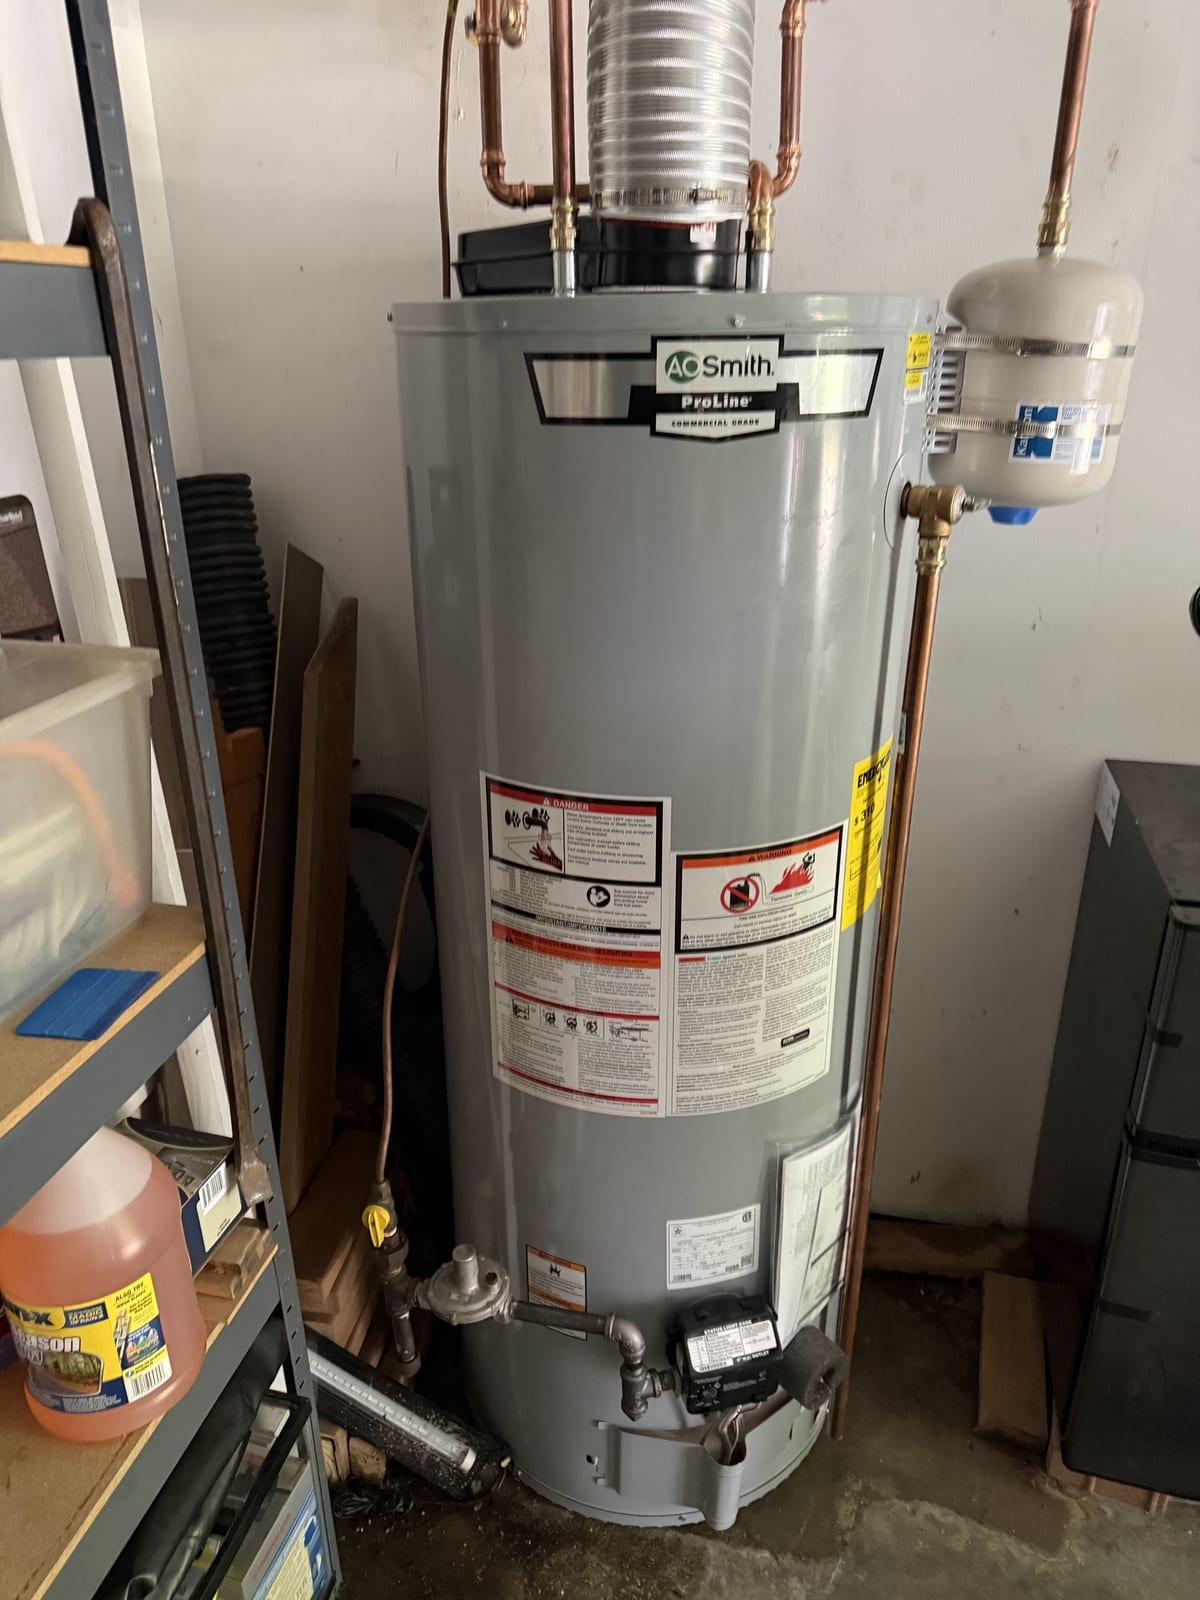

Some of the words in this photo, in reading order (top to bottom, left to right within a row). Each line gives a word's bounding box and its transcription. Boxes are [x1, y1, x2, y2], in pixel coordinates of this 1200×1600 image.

[681, 394, 749, 409] ProLine
[671, 419, 728, 428] COMMERCIAL
[731, 418, 760, 427] GRADE
[553, 799, 590, 811] DANGER
[757, 848, 792, 861] WARNING
